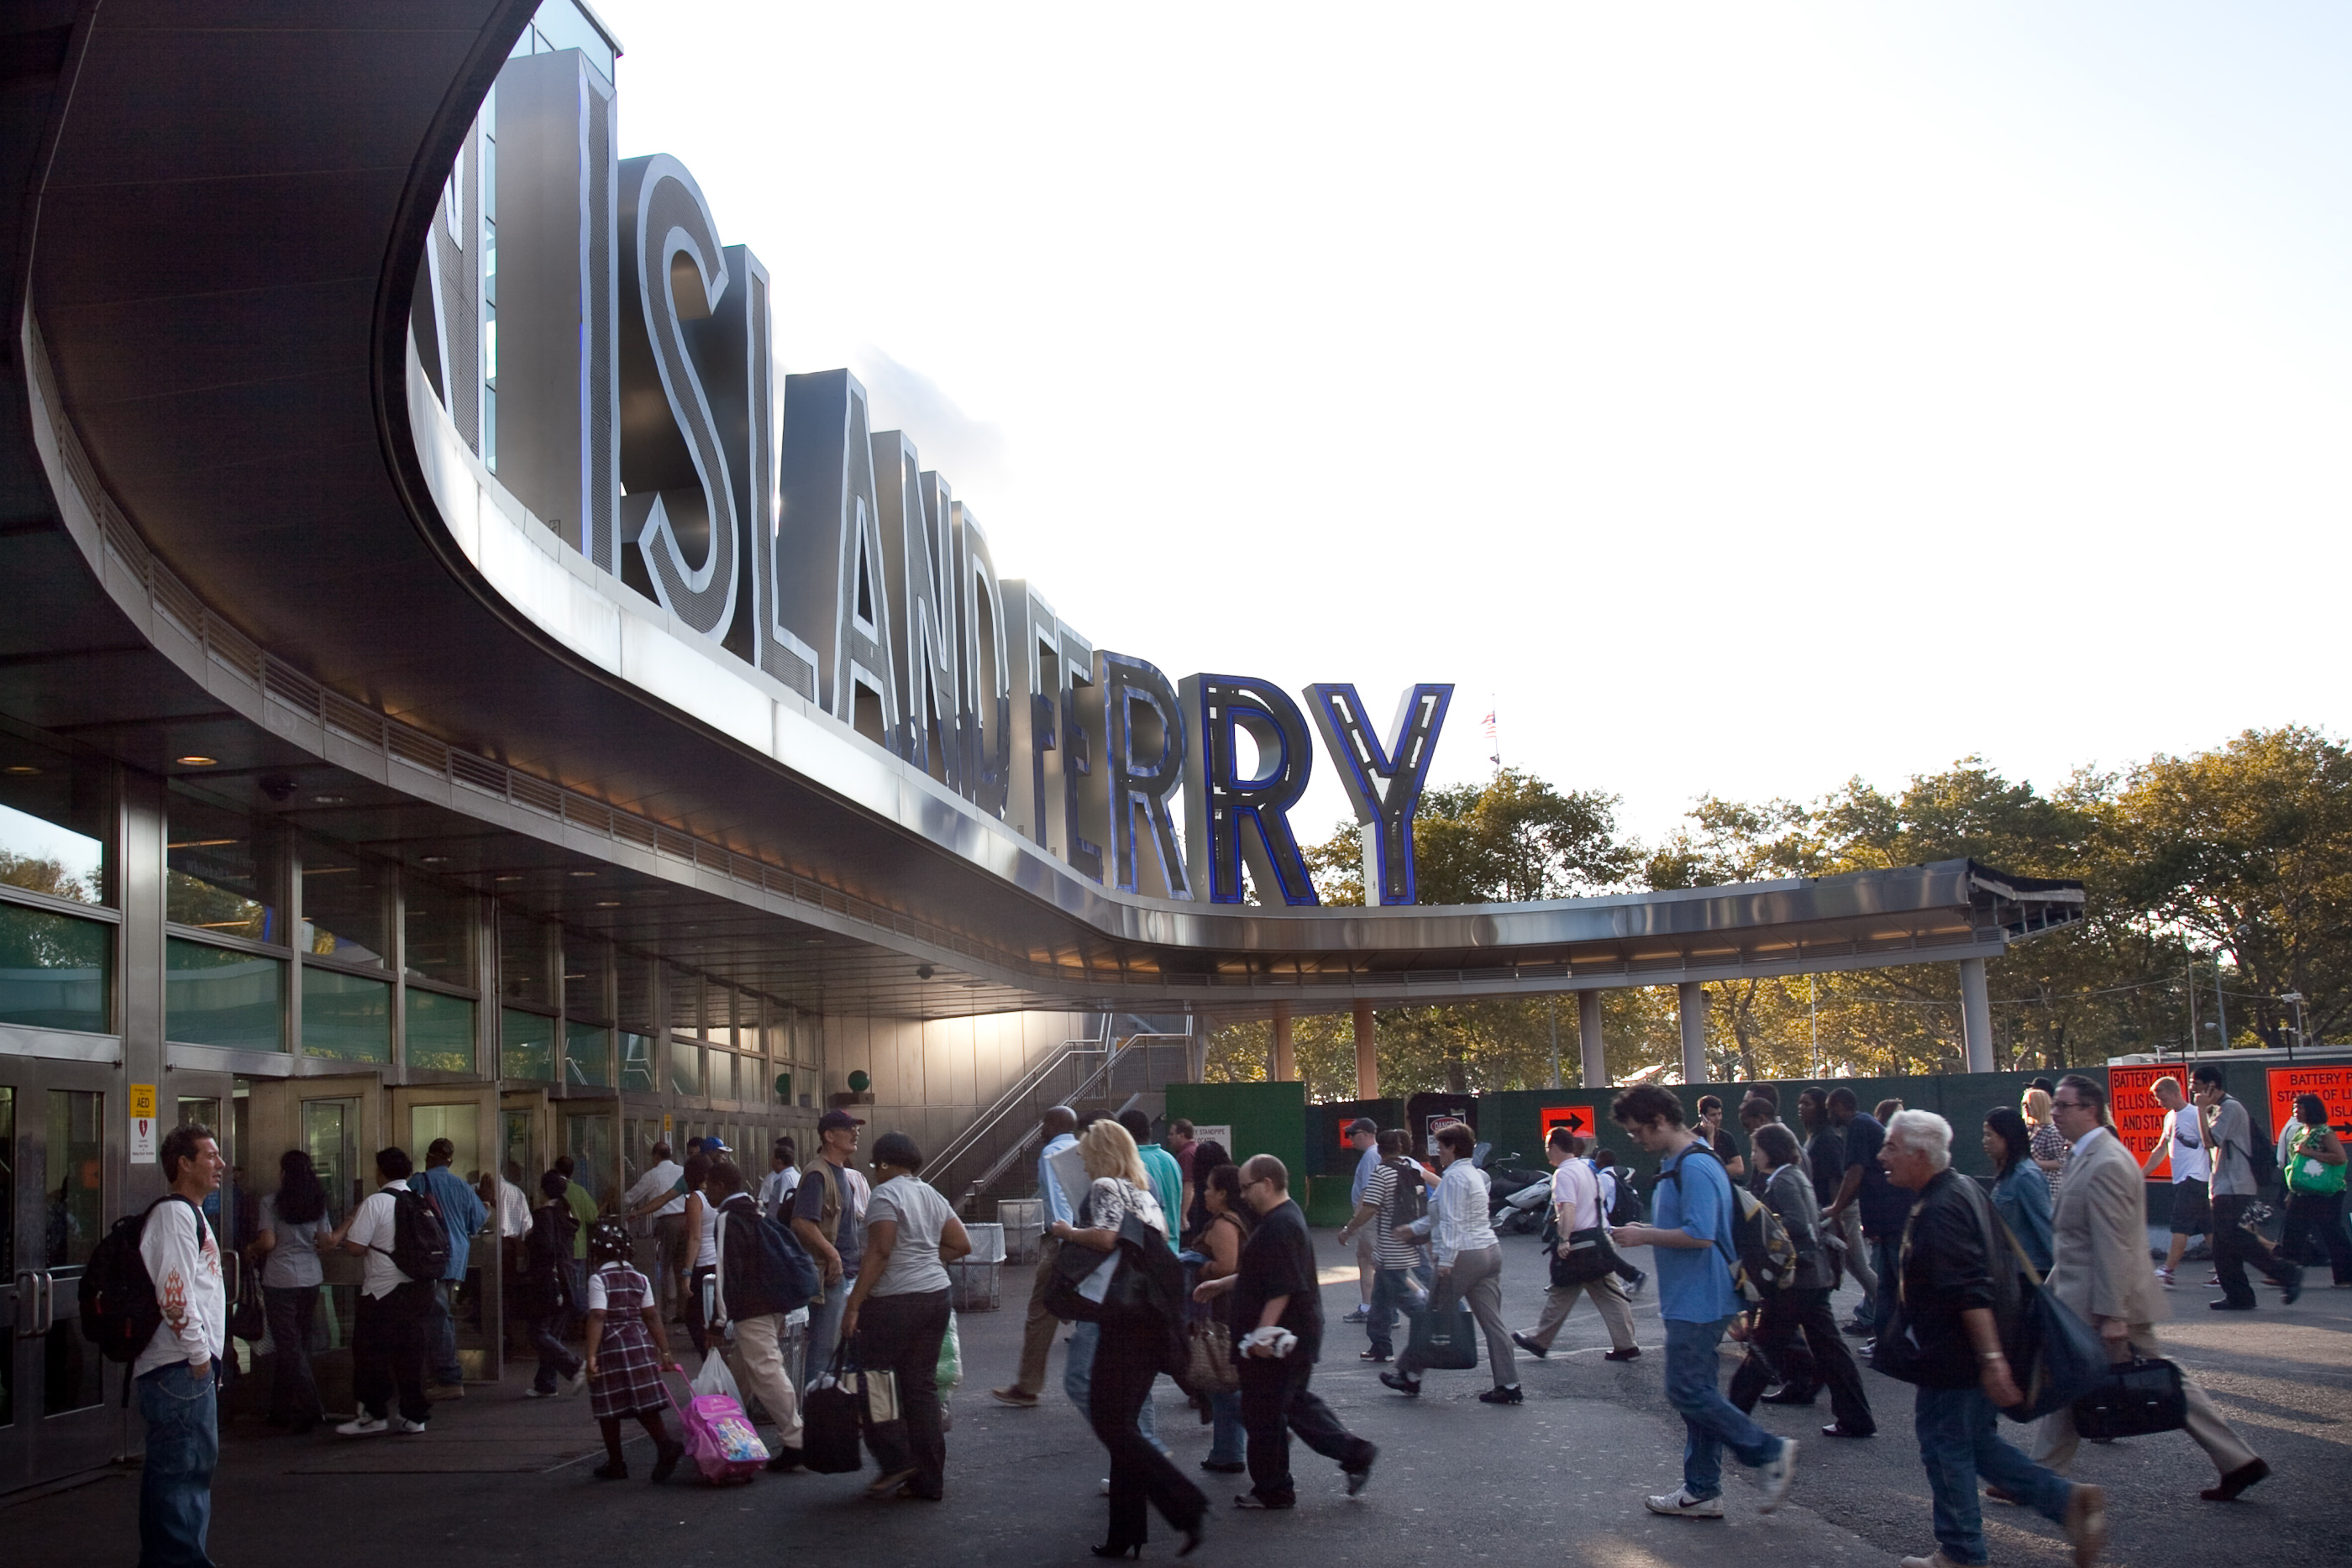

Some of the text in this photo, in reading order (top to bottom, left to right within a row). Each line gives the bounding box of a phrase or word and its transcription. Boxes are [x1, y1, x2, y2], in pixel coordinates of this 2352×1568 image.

[571, 47, 1010, 823] ISLAND
[1021, 579, 1456, 905] FERRY
[2113, 1072, 2154, 1088] BATTERY
[2291, 1073, 2340, 1085] BATTERY
[137, 1097, 150, 1108] AED
[2117, 1093, 2145, 1110] ELLIS
[2323, 1089, 2338, 1101] OF
[1434, 1120, 1456, 1130] DANG
[2123, 1114, 2165, 1130] AND STAT
[2124, 1136, 2160, 1152] OF LIBE
